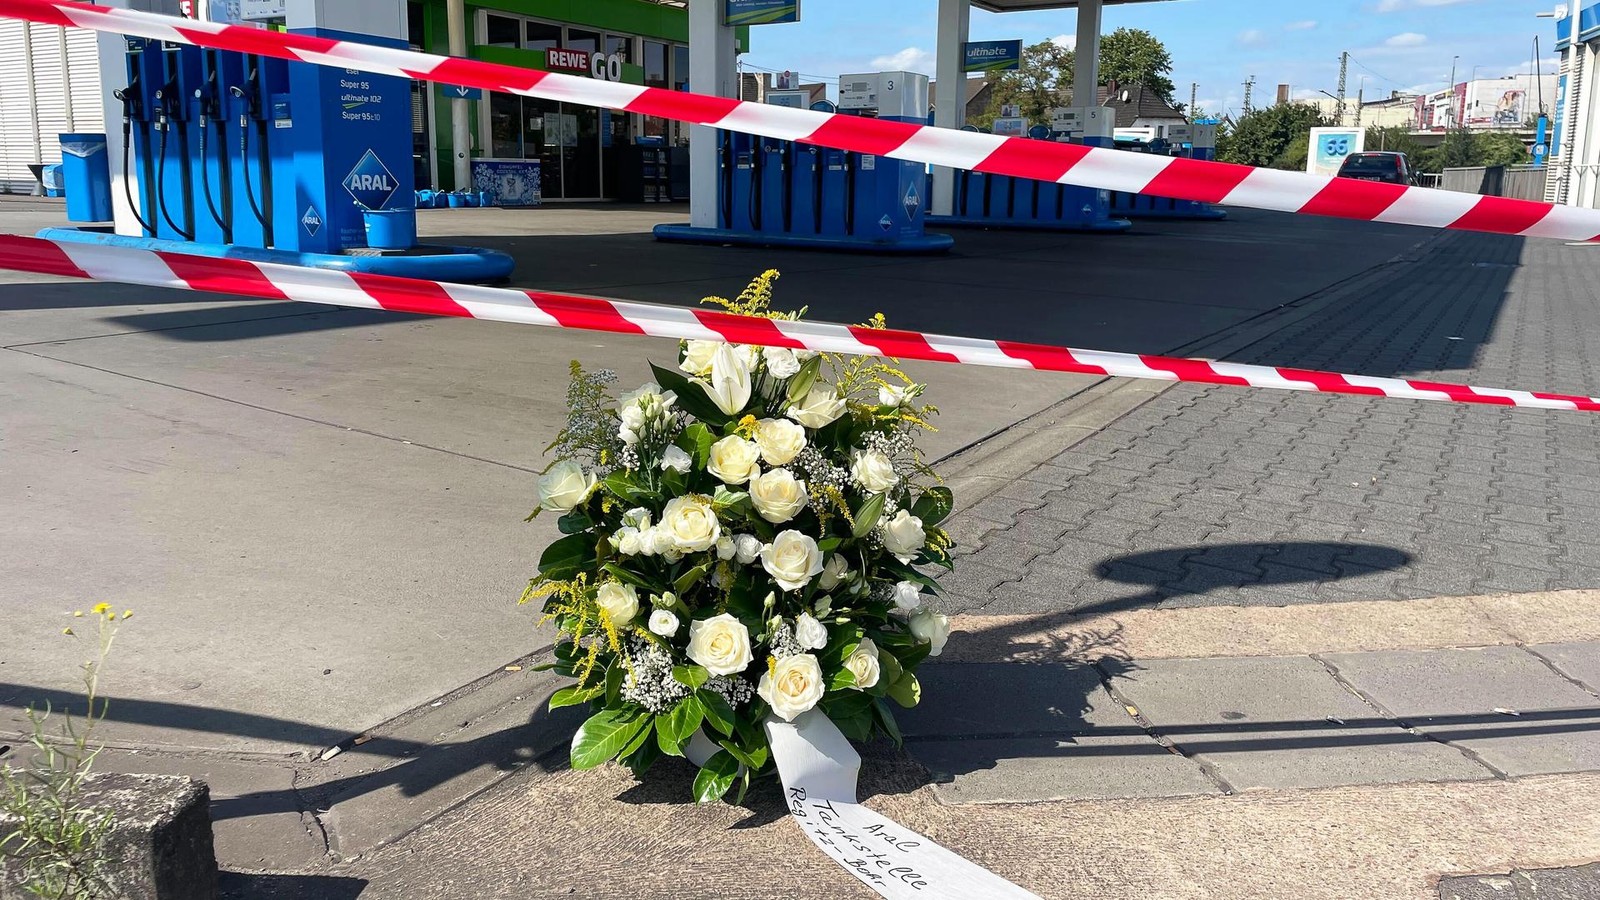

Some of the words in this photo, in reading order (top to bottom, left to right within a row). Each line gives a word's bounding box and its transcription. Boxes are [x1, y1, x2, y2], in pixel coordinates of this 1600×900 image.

[967, 46, 1007, 57] ultimate
[549, 50, 587, 69] REWE
[591, 52, 622, 82] GO
[340, 79, 360, 89] Super
[360, 81, 370, 90] 95
[887, 80, 894, 91] 3
[341, 94, 369, 103] ultimate
[370, 95, 382, 103] 102
[342, 111, 361, 121] Super
[1091, 111, 1096, 119] 5
[1327, 138, 1348, 156] 66
[350, 174, 392, 191] ARAL
[904, 195, 919, 206] ARAL
[304, 216, 320, 225] ARAL
[862, 823, 921, 853] Aral
[812, 799, 928, 891] Tankstelle
